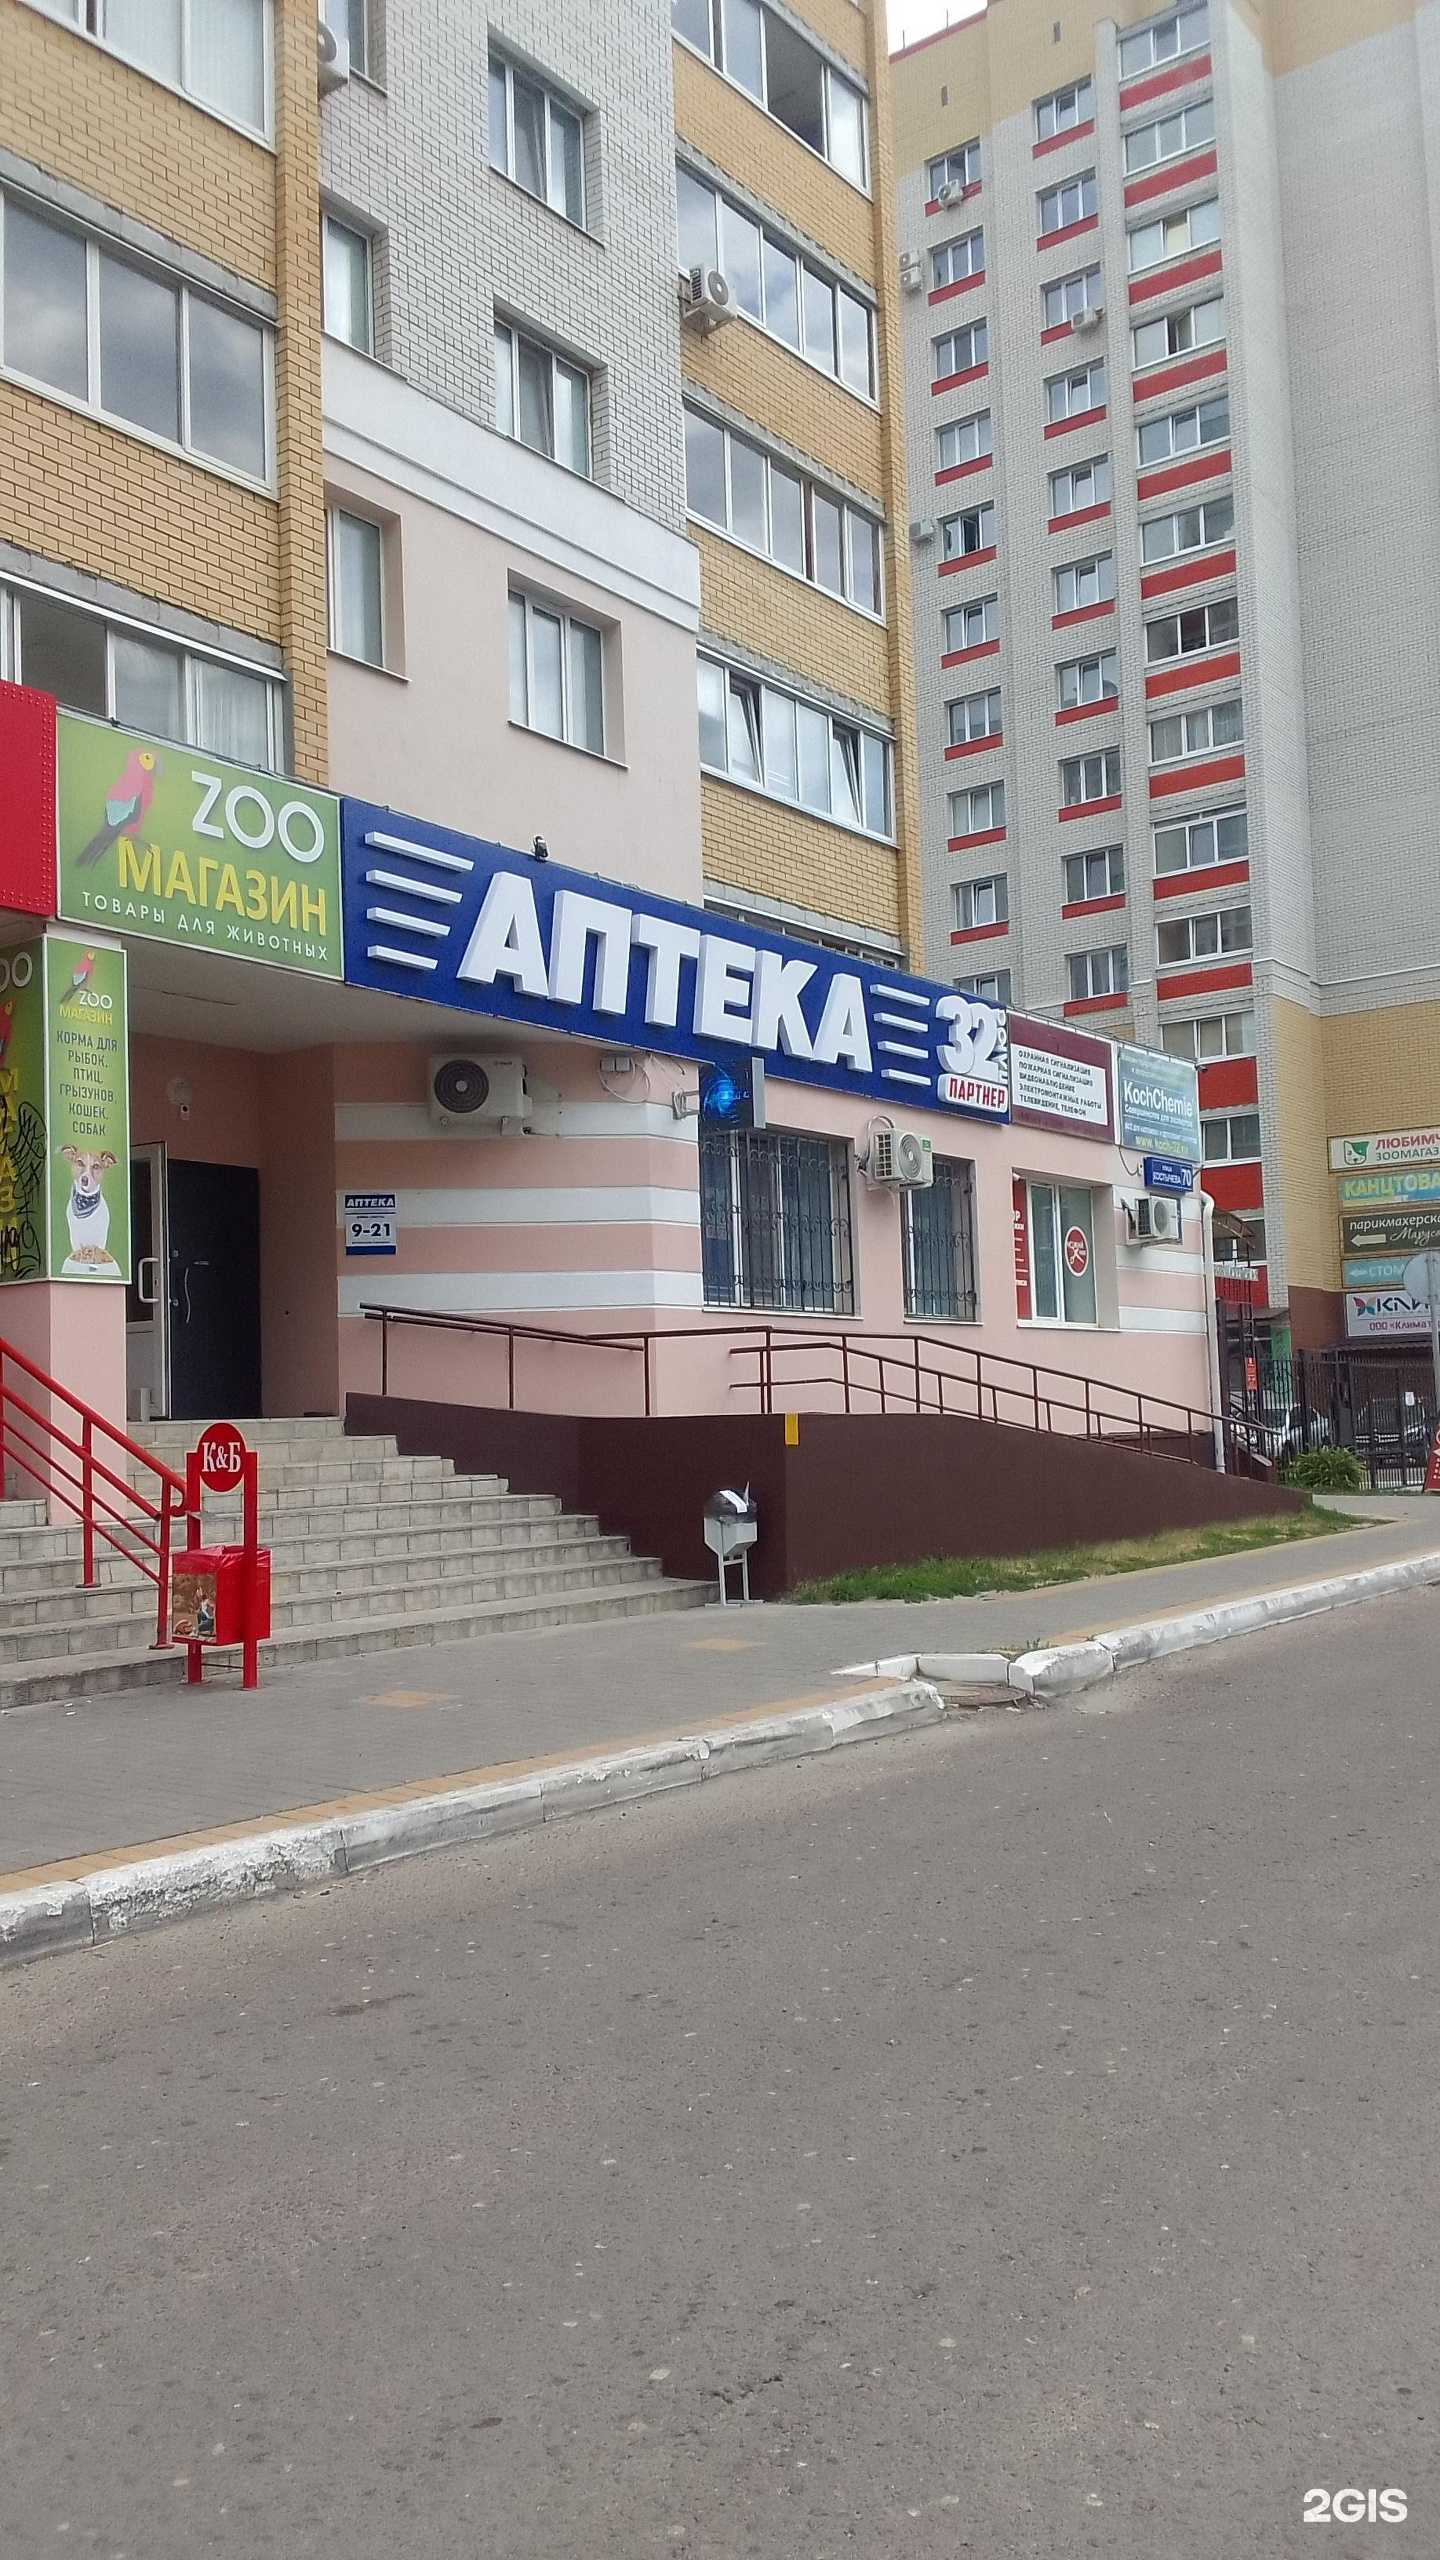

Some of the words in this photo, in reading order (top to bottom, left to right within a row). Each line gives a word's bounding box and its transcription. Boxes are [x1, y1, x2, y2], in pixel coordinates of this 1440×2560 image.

[192, 770, 325, 863] ZOO
[117, 837, 326, 936] МАГАЗИН
[82, 891, 165, 924] ТОВАРЫ
[177, 913, 216, 936] ДЛЯ
[226, 924, 328, 961] ЖИВОТНЫХ
[456, 871, 873, 1073] АПТЕКА
[80, 990, 112, 1009] ZOO
[60, 1004, 112, 1026] МАГАЗИН
[57, 1029, 93, 1049] КОРМА
[96, 1037, 118, 1052] ДЛЯ
[936, 995, 999, 1083] 32
[1018, 1050, 1049, 1064] ОХРАННАЯ
[1019, 1061, 1051, 1076] ПОЖАРНАЯ
[949, 1077, 1006, 1109] ПАРТНЕР
[1123, 1080, 1193, 1117] KochChemie
[72, 1121, 106, 1136] СОБАК
[1181, 1168, 1192, 1187] 70
[347, 1198, 394, 1207] АПТЕКА
[352, 1223, 390, 1237] 9-21
[1369, 1264, 1405, 1277] СТОМ
[1377, 1297, 1429, 1312] КЛИ
[202, 1441, 241, 1473] К&Б
